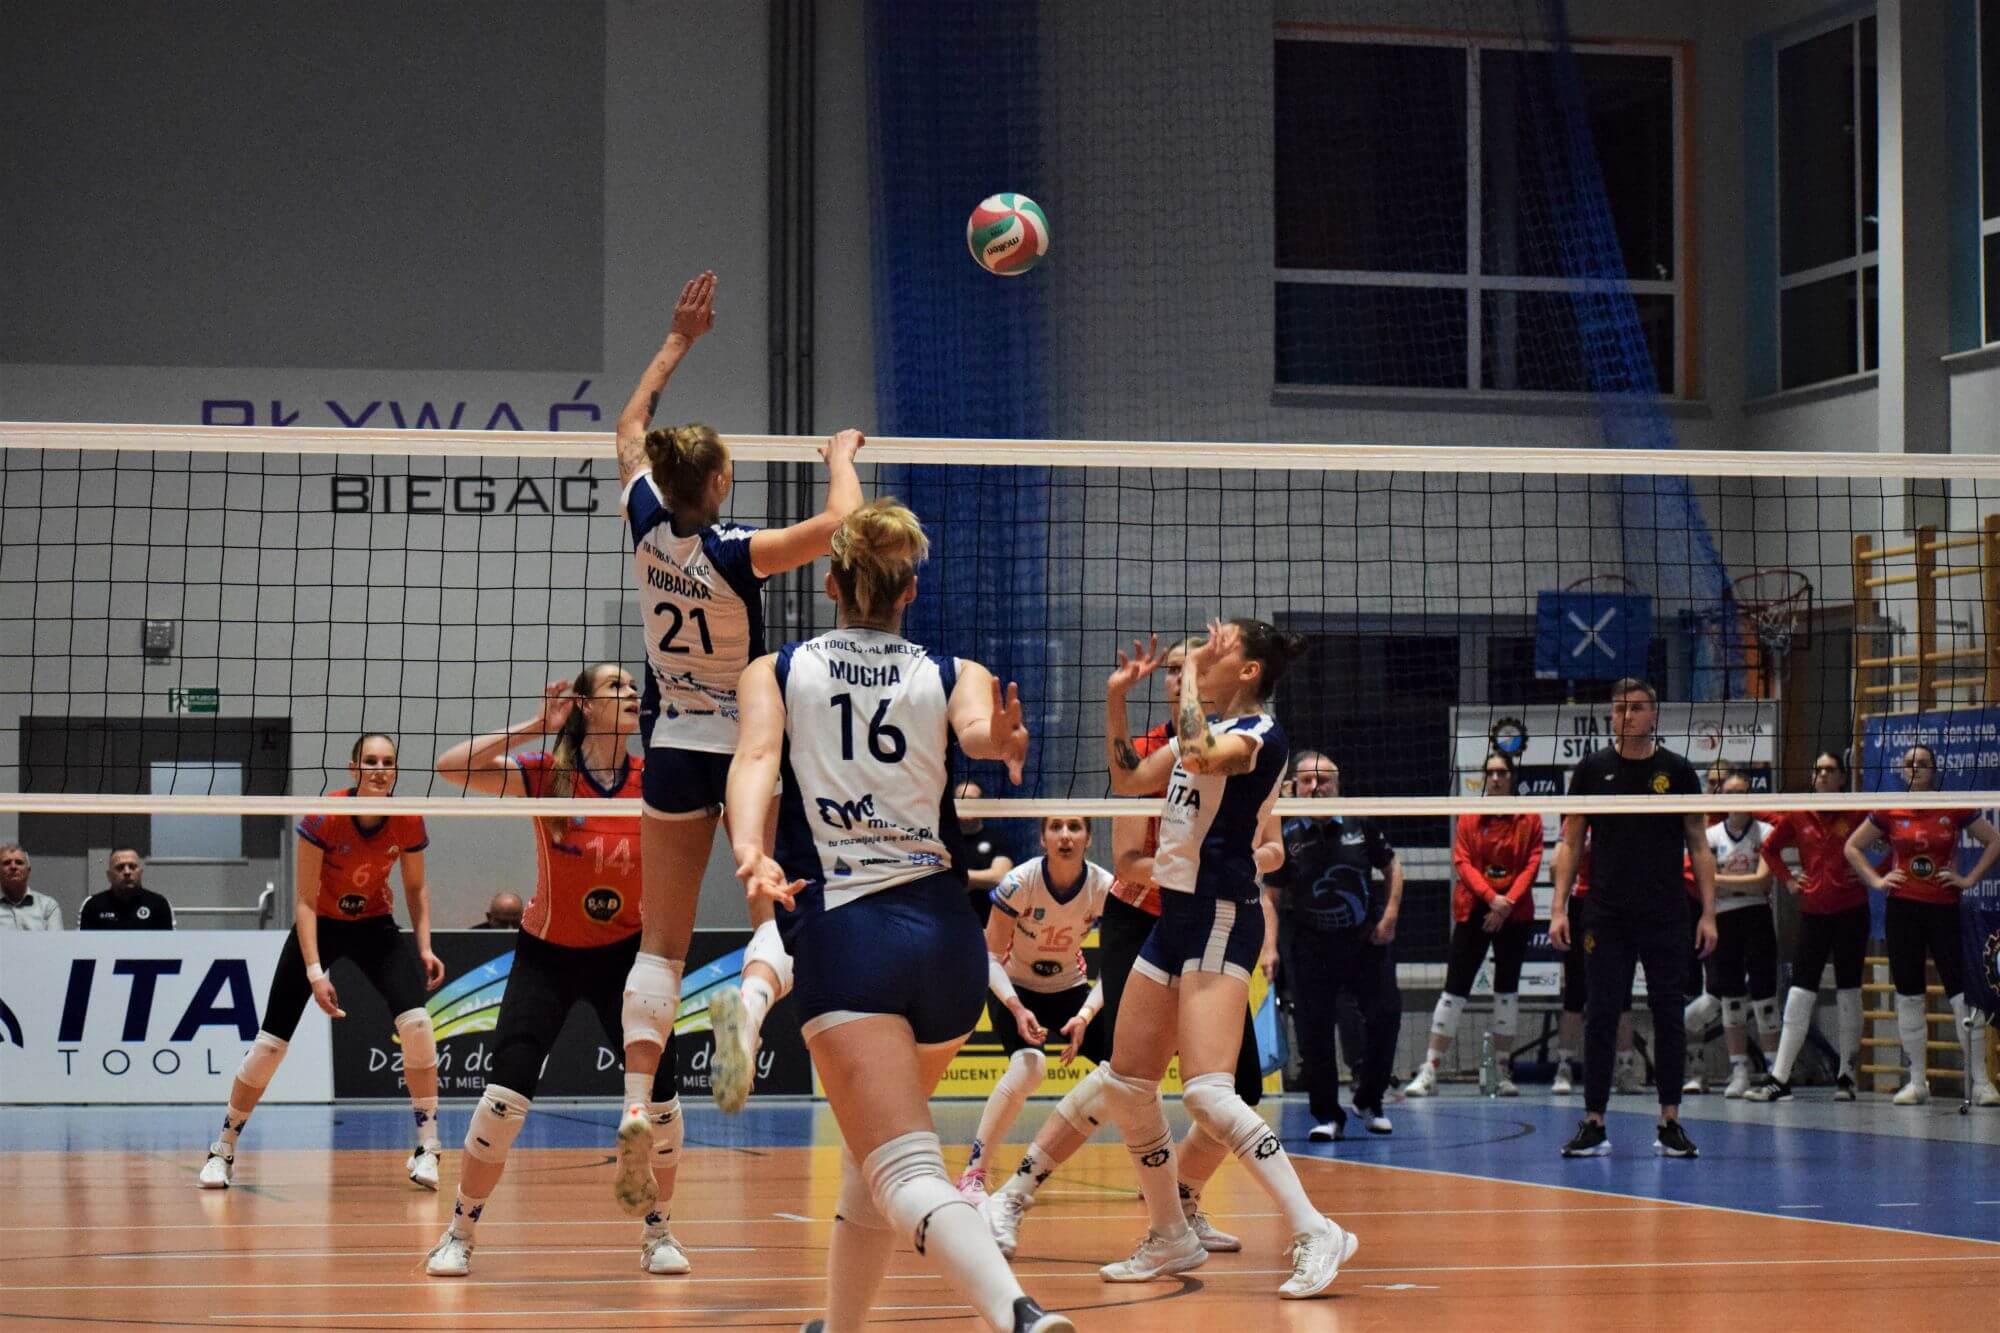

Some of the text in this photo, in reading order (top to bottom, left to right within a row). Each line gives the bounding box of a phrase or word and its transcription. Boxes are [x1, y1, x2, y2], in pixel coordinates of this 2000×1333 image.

[331, 460, 599, 514] BIEGAĆ
[648, 565, 712, 600] KUBACKA
[654, 602, 713, 655] 21
[824, 640, 856, 654] TOOLS
[828, 659, 901, 688] MUCHA
[830, 692, 907, 764] 16
[1574, 716, 1598, 736] ITA
[1167, 783, 1200, 810] ITA
[1532, 780, 1556, 793] ITA
[585, 835, 636, 876] 14
[352, 863, 372, 888] 6
[1040, 925, 1074, 947] 16
[57, 958, 261, 1043] ITA
[57, 1048, 250, 1077] TOOL
[368, 1047, 452, 1073] Dzń
